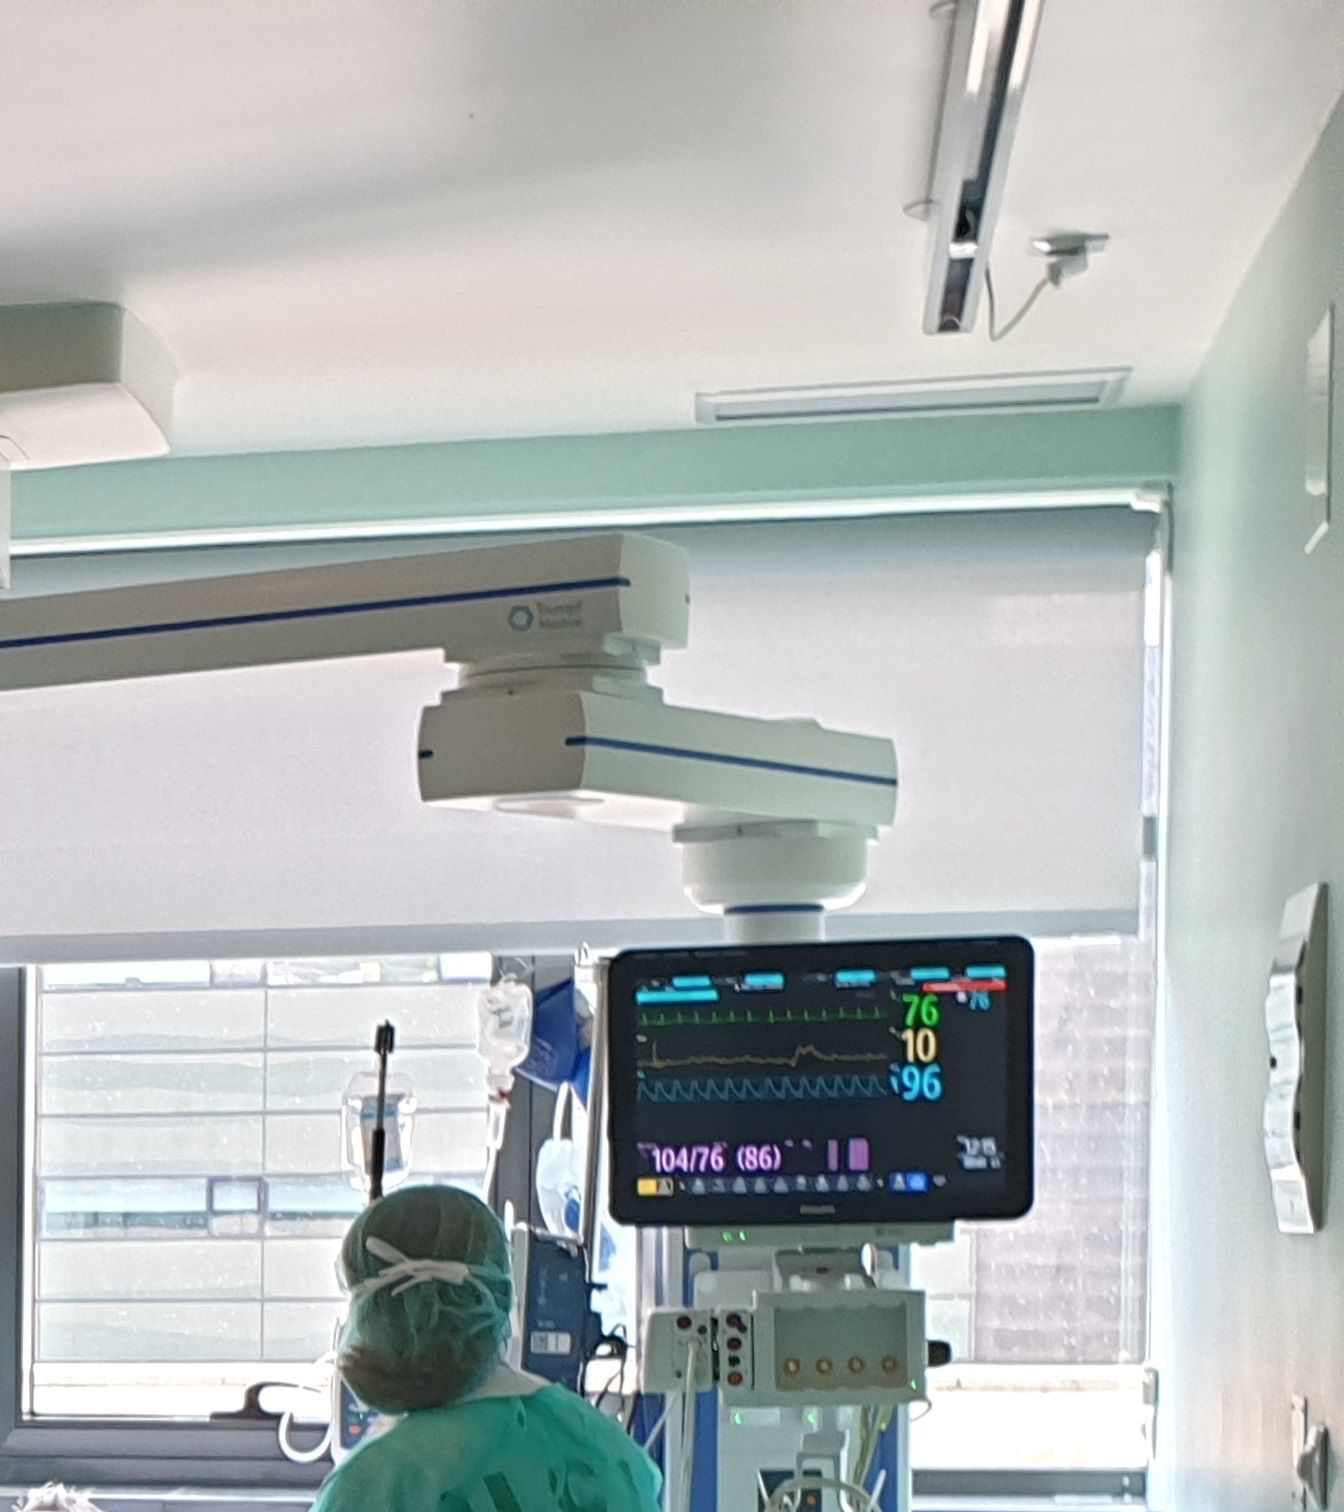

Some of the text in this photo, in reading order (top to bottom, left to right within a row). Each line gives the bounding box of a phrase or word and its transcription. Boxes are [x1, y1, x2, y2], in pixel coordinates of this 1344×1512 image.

[902, 993, 940, 1027] 76
[900, 1028, 937, 1062] 10
[901, 1064, 943, 1101] 96
[652, 1143, 781, 1172] 104/76 (86)
